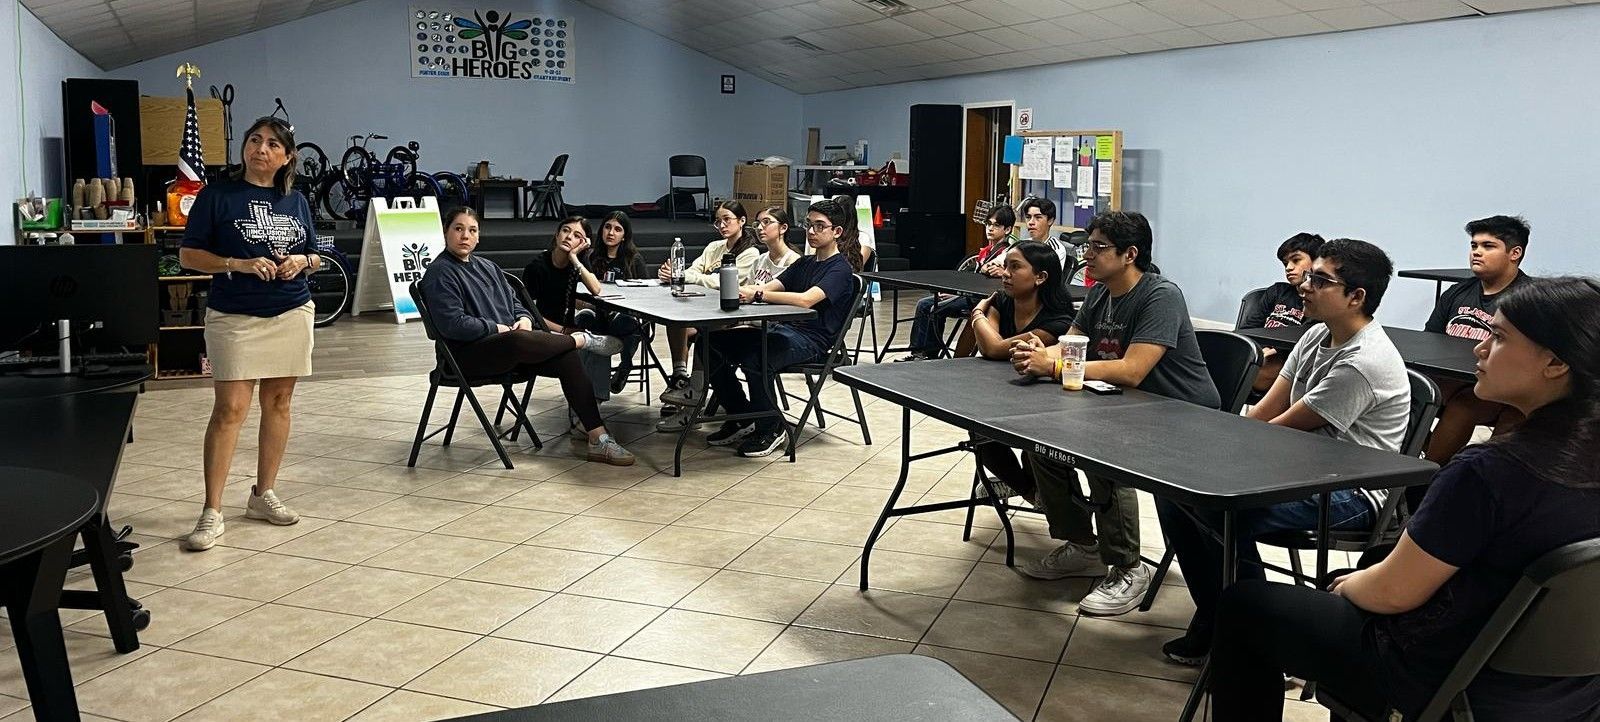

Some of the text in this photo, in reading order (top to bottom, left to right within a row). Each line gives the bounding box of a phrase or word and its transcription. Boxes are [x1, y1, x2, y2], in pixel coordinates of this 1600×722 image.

[471, 40, 517, 61] BIG
[452, 57, 533, 79] HEROES
[393, 271, 422, 282] HER
[1035, 443, 1076, 465] BIG HEROES
